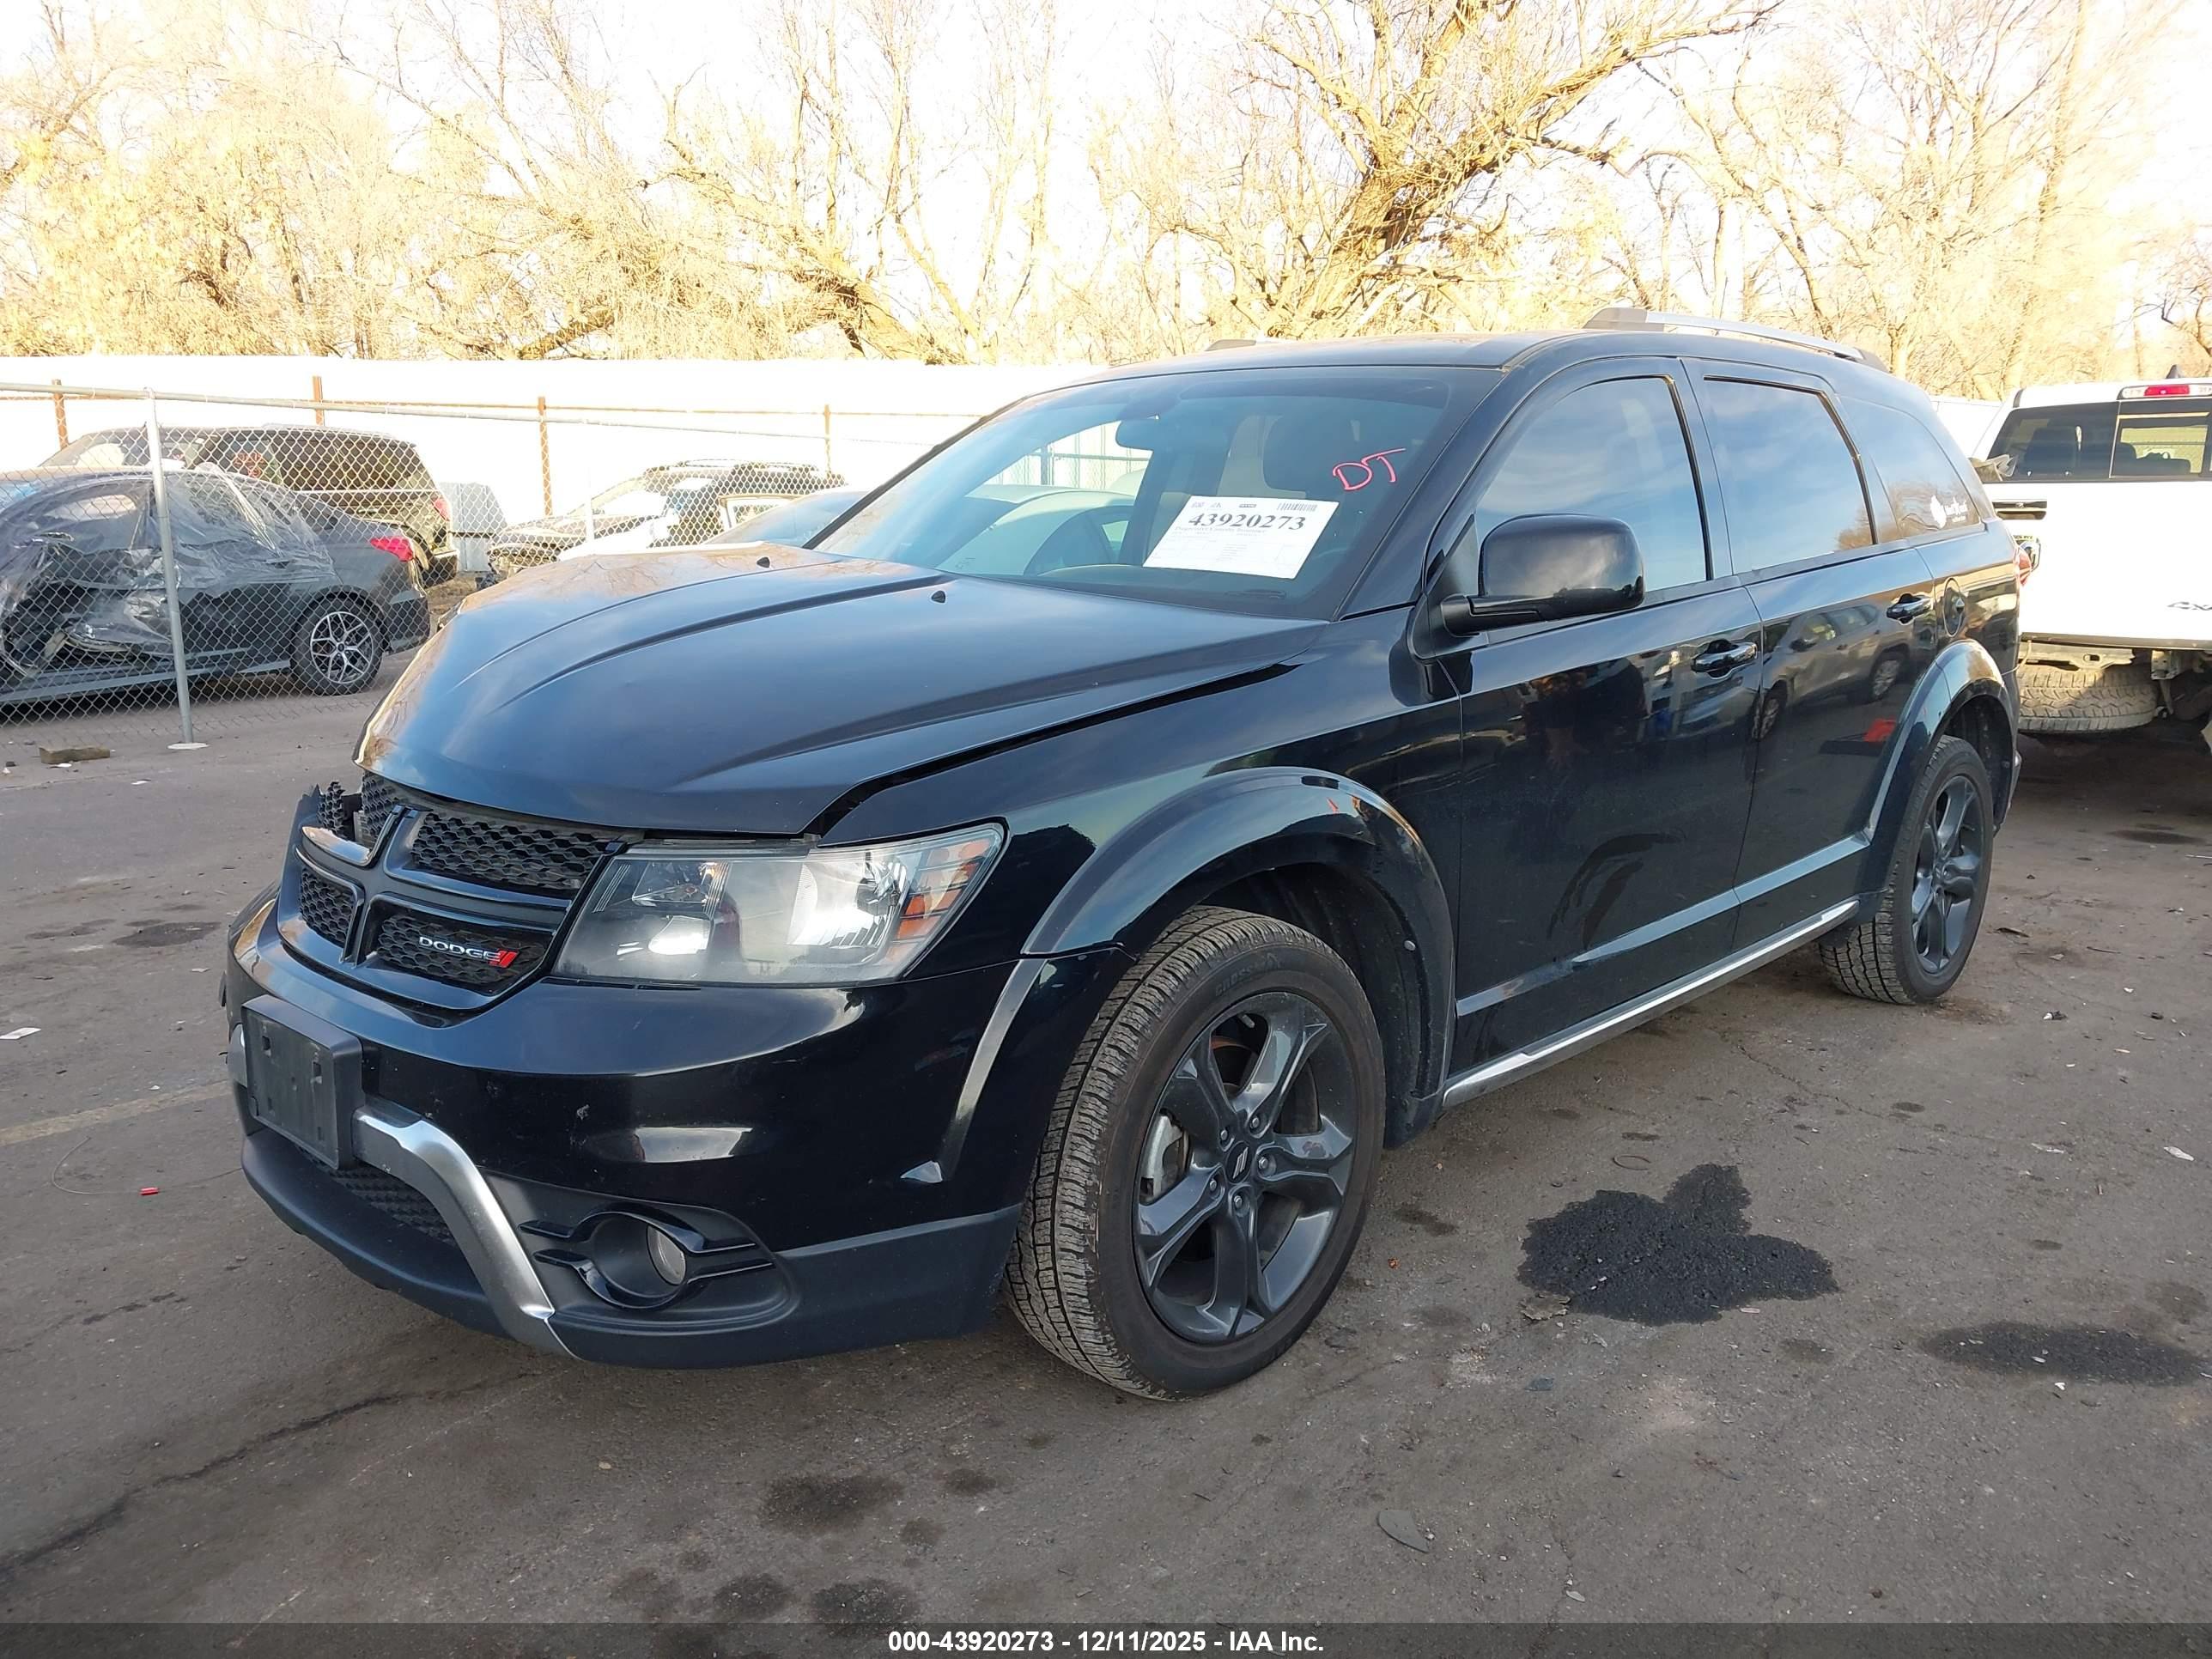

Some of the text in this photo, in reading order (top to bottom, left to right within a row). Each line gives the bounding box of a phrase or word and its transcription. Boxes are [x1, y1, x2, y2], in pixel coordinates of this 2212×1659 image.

[1332, 447, 1407, 490] DT
[1188, 513, 1306, 531] 43920273
[418, 936, 501, 963] DODGE
